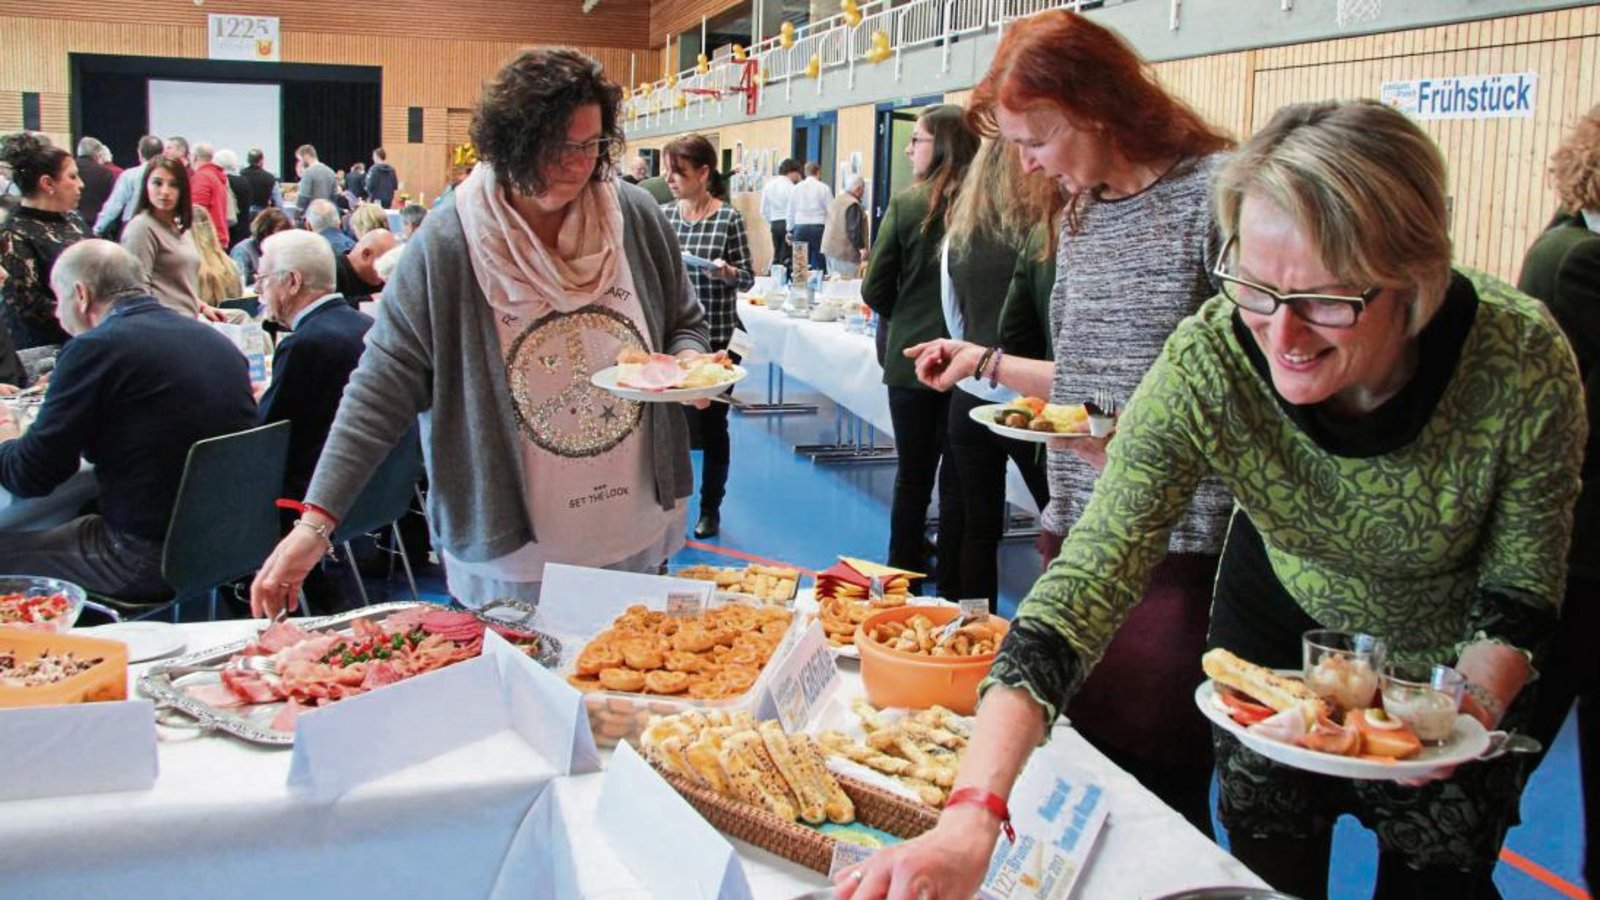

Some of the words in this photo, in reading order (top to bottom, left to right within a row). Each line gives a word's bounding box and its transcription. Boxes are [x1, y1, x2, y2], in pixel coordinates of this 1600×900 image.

[216, 17, 269, 38] 1225
[1418, 75, 1531, 113] Frühstück
[588, 491, 604, 503] THE
[605, 487, 628, 499] LOOK
[1007, 835, 1036, 875] Brunch
